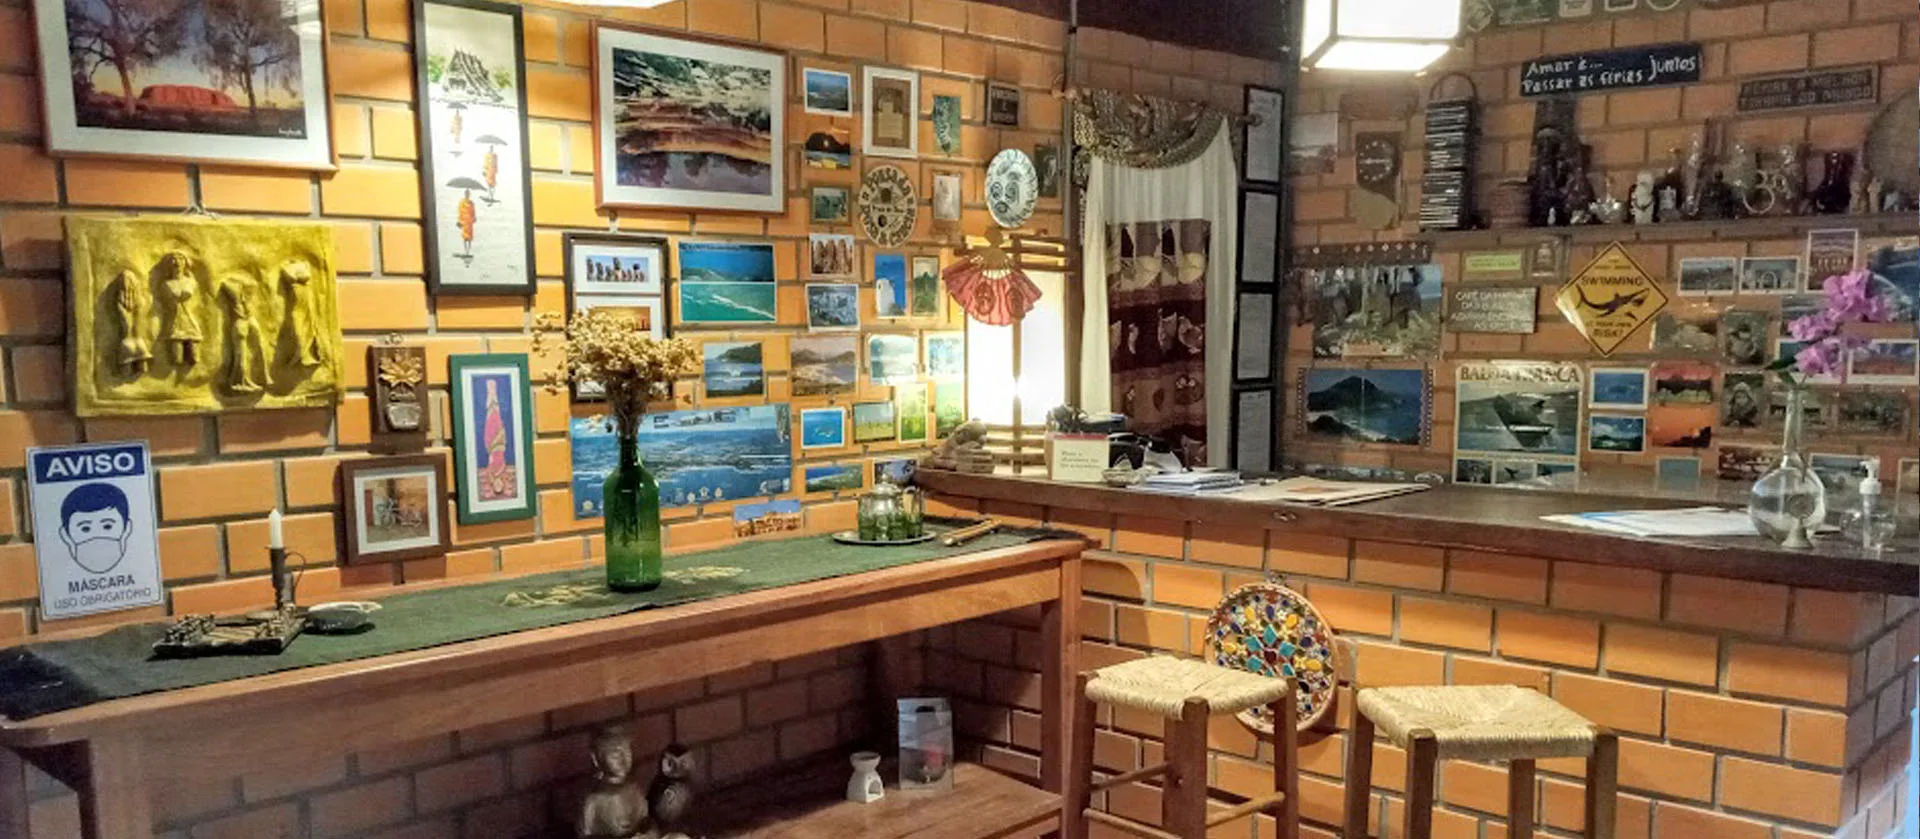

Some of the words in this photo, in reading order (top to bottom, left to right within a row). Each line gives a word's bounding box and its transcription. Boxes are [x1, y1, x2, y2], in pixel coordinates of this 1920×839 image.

[1526, 60, 1574, 77] Amar
[1522, 76, 1573, 94] Passar
[1581, 276, 1643, 286] SWIMMING
[46, 452, 135, 478] AVISO
[54, 596, 78, 609] USO
